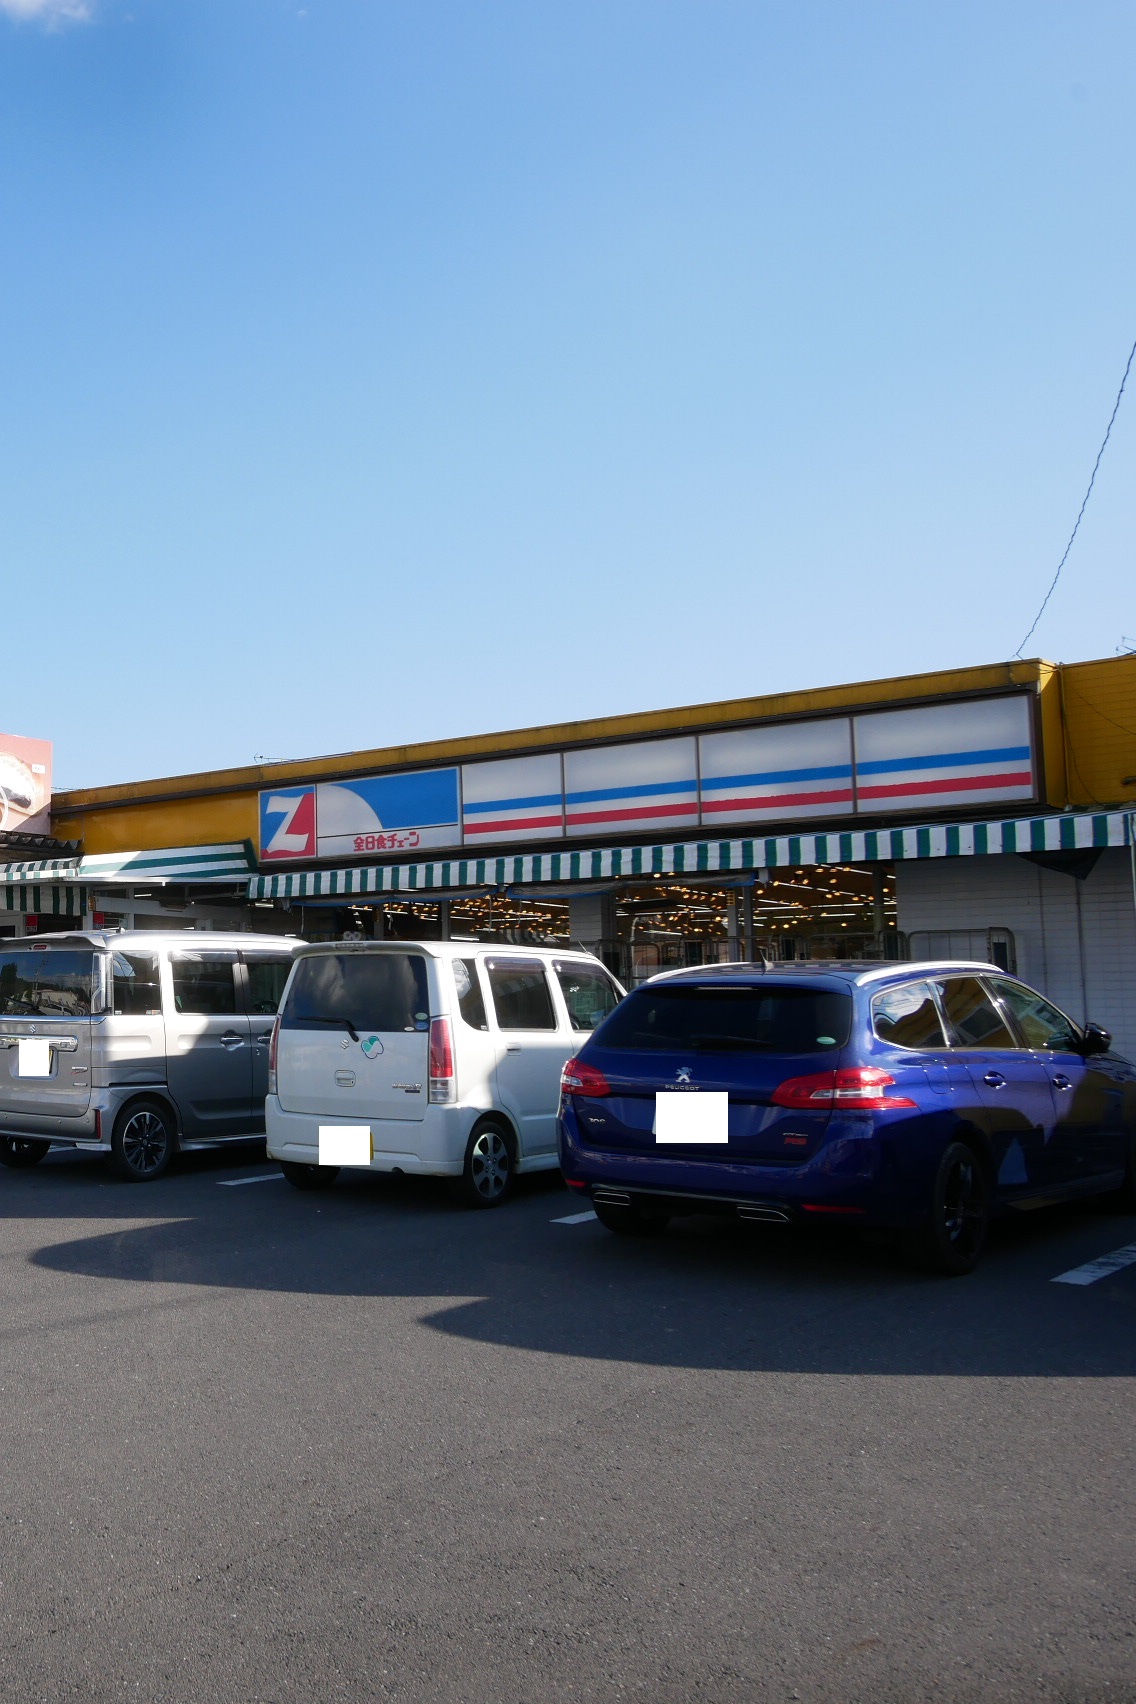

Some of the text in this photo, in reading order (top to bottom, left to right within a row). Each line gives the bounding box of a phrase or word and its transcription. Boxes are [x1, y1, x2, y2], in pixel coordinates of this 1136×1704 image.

[353, 831, 420, 852] 全日食チェーン
